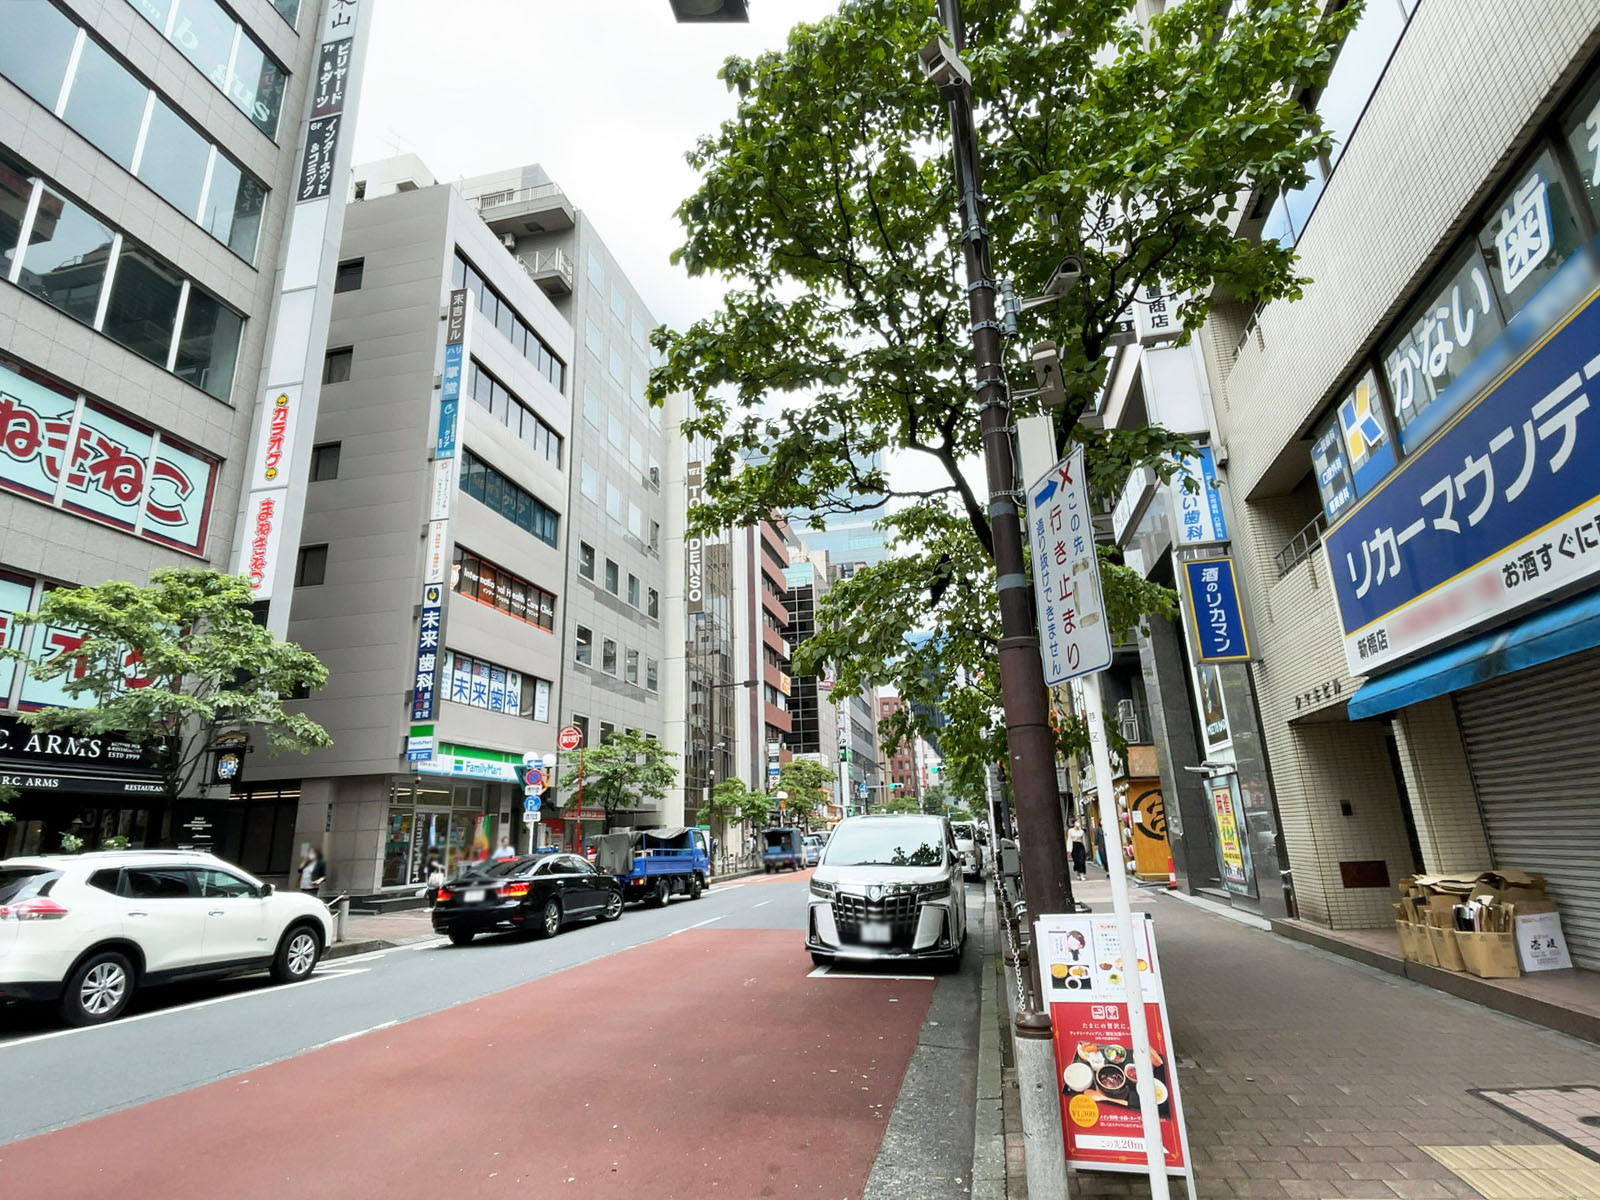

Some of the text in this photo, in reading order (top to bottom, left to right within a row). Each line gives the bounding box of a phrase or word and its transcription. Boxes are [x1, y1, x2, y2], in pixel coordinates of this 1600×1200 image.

[331, 42, 351, 105] ビリヤード
[303, 143, 320, 198] &コミック
[318, 119, 337, 195] インターネット
[265, 406, 289, 467] カラオケ
[250, 498, 276, 590] まねきねこ
[1069, 492, 1085, 555] この先
[1036, 518, 1061, 676] 通り抜けできません
[1049, 504, 1080, 671] 行き止まり
[1201, 567, 1230, 652] 酒のリカマン
[416, 610, 440, 692] 未来歯科
[453, 676, 519, 710] 未来歯科
[24, 734, 102, 758] ARMS
[465, 760, 502, 776] FamilyMart
[26, 777, 59, 788] ARMS
